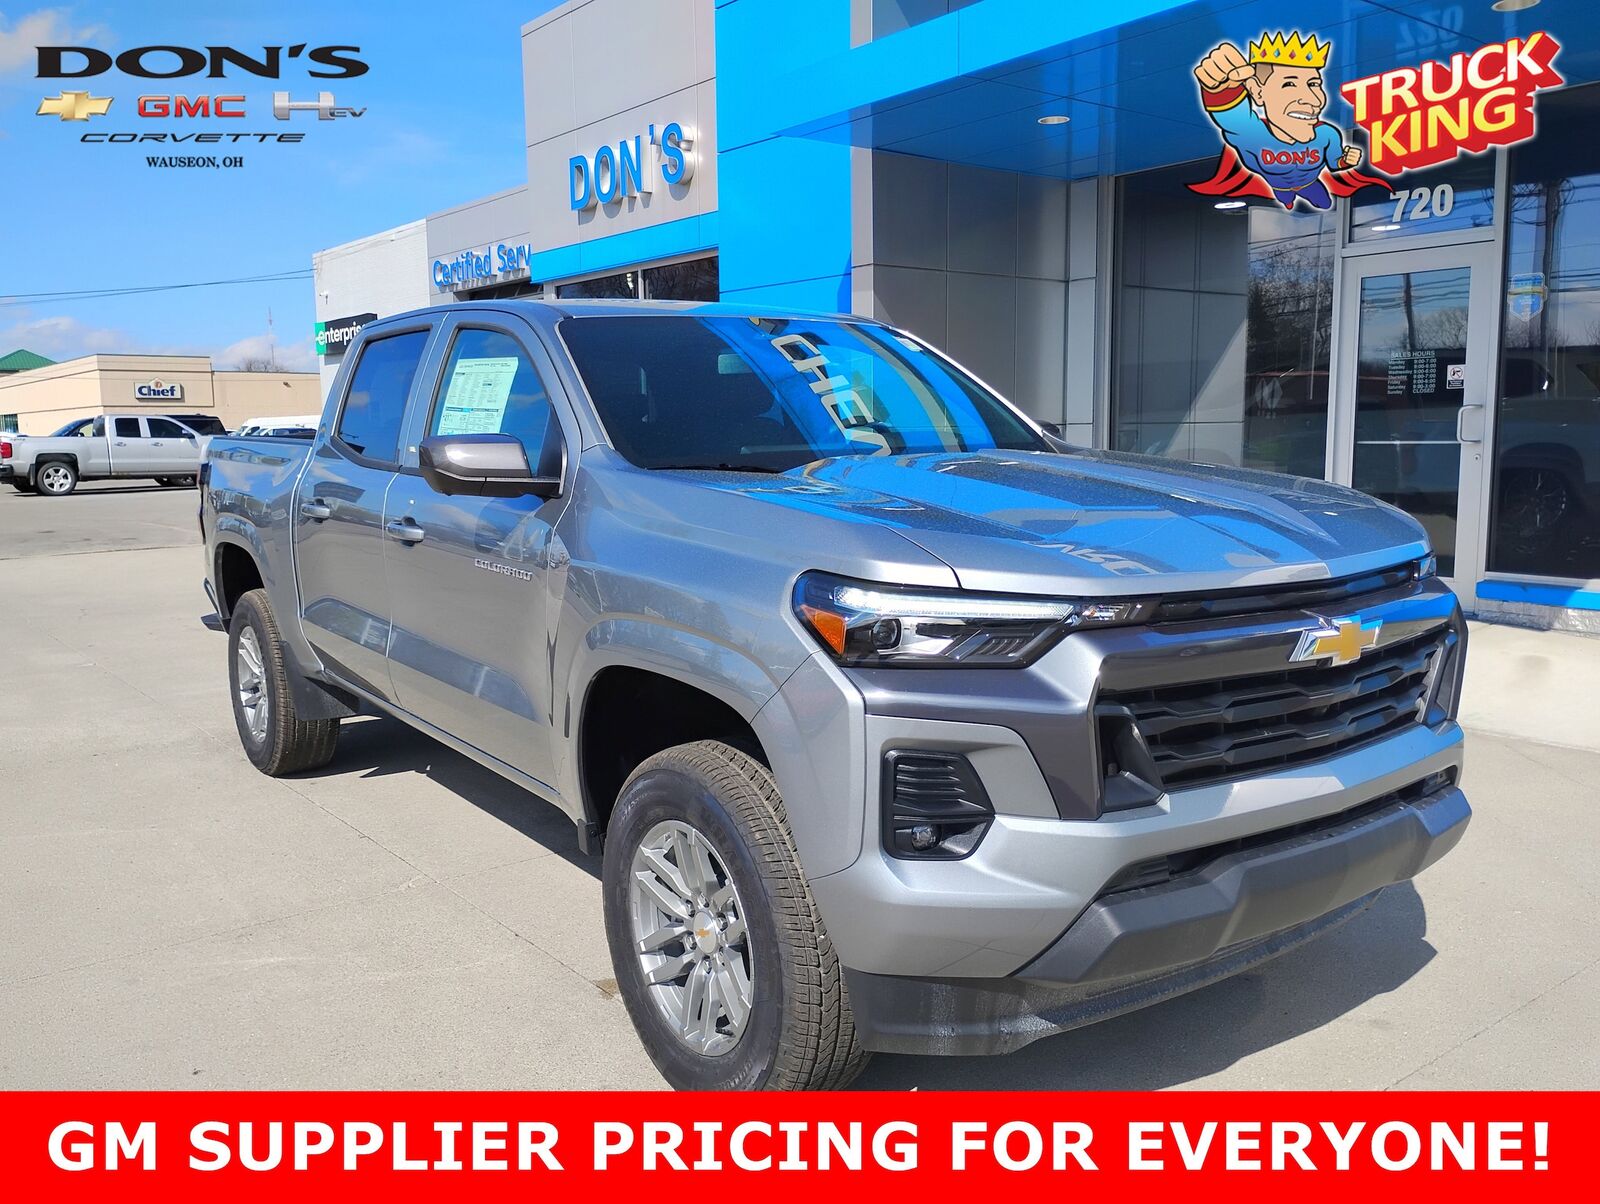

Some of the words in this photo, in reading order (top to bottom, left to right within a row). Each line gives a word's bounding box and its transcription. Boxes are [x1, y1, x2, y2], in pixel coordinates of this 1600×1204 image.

[568, 122, 687, 212] DON'S
[1389, 183, 1454, 222] 720
[433, 245, 492, 288] Certified
[137, 384, 177, 398] Chief
